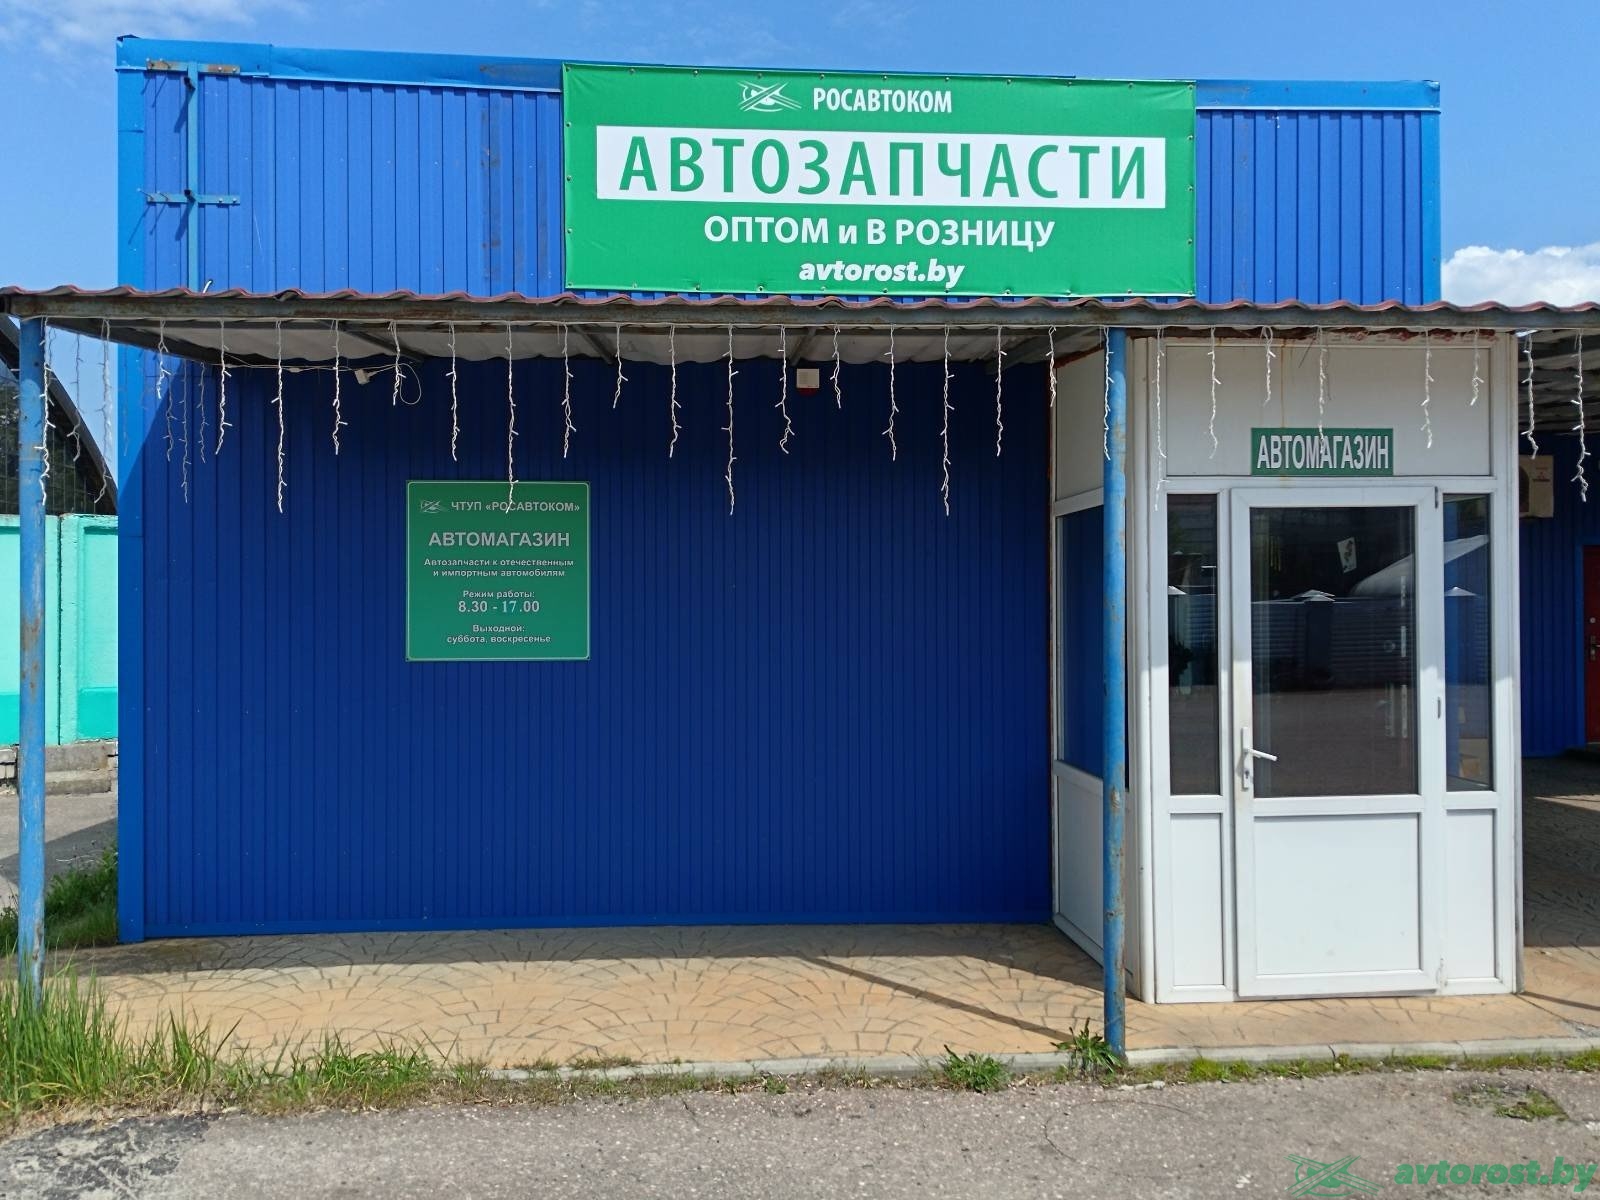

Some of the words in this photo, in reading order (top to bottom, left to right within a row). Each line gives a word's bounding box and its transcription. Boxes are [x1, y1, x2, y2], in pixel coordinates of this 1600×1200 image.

[812, 87, 953, 114] РОСАВТОКОМ
[619, 135, 1146, 200] АВТОЗАПЧАСТИ
[704, 215, 829, 245] ОПТОМ
[838, 224, 857, 245] и
[867, 218, 887, 245] В
[896, 218, 1056, 252] РОЗНИЦУ
[798, 258, 965, 289] avtorost.by
[1257, 434, 1389, 469] АВТОМАГАЗИН
[451, 501, 482, 511] ЧТУП
[485, 501, 580, 513] «РОСАВТОКОМ»
[428, 532, 570, 547] АВТОМАГАЗИН
[424, 558, 490, 566] Автозапчасти
[441, 570, 498, 578] импортным
[500, 569, 565, 577] автомобилям
[463, 590, 494, 598] Режим
[496, 590, 535, 599] работы:
[458, 601, 488, 612] 8.30
[502, 601, 540, 612] 17.00
[472, 624, 525, 633] Выходной:
[447, 635, 488, 644] суббота,
[490, 636, 551, 644] воскресенье
